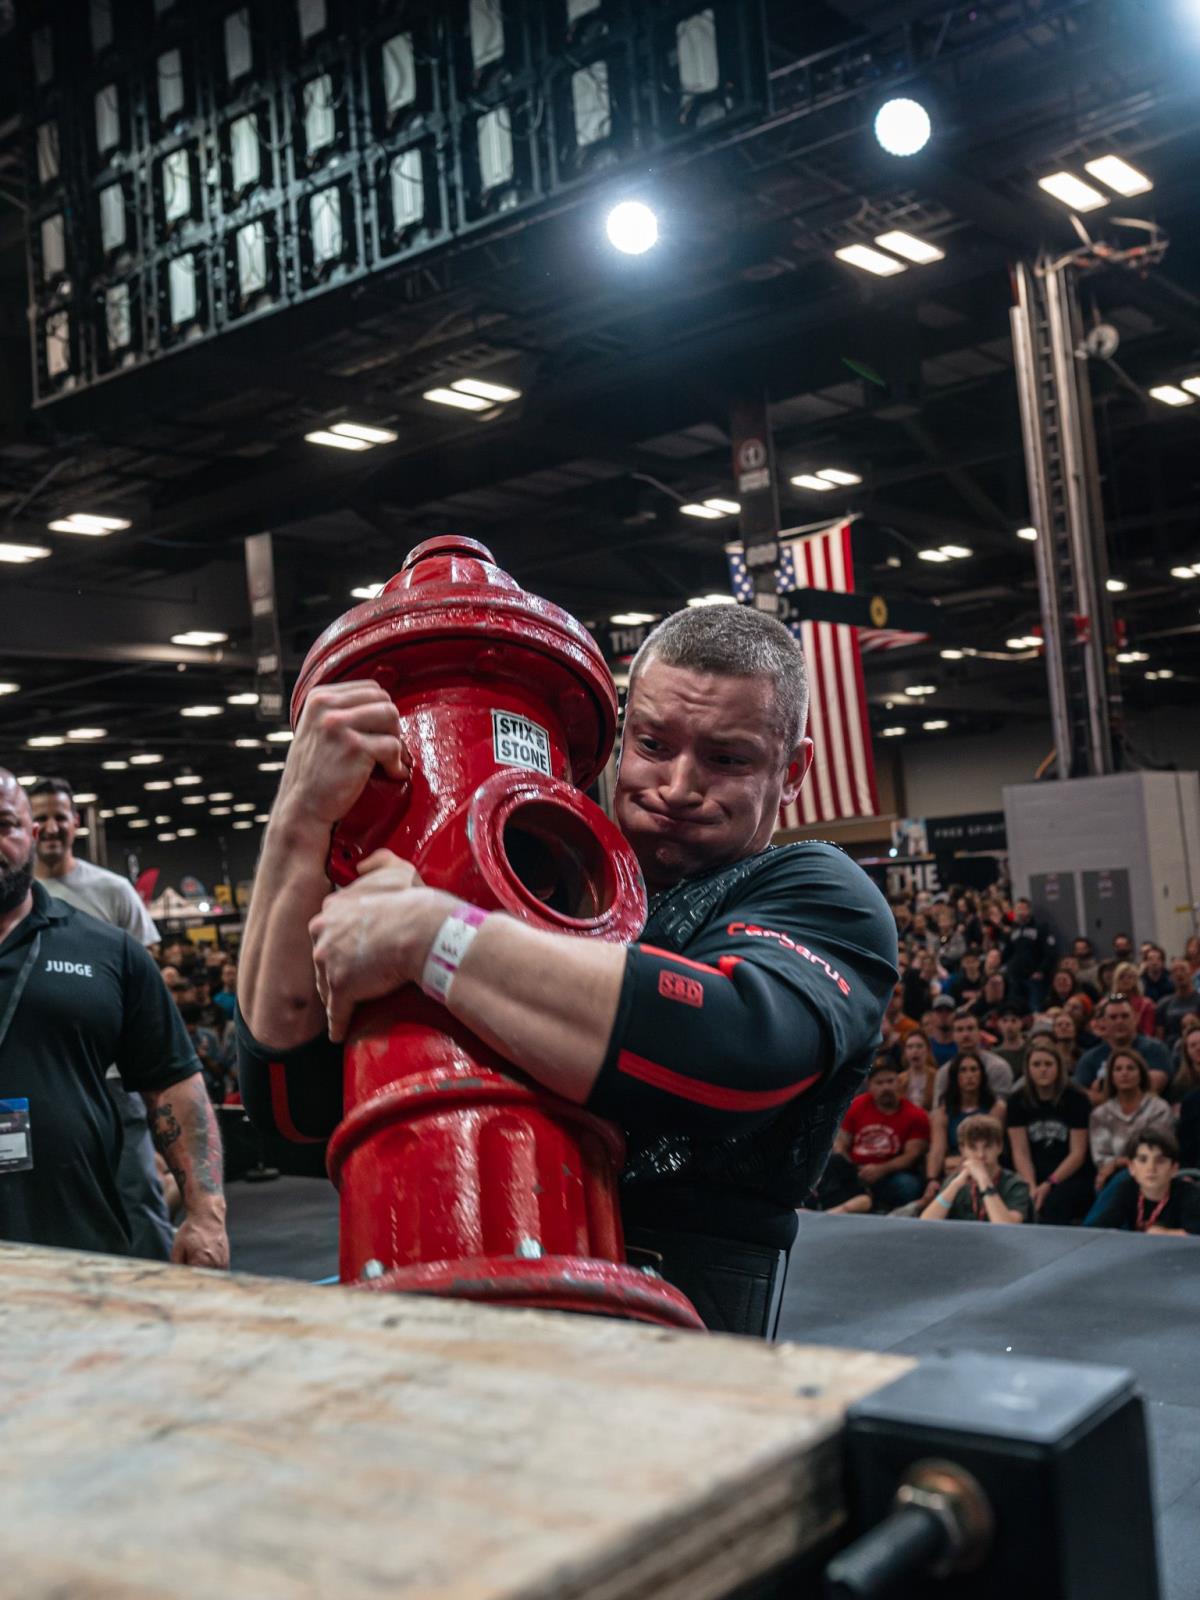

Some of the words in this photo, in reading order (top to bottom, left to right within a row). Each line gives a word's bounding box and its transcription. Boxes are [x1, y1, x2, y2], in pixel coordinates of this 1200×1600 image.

[500, 717, 534, 745] STIX
[501, 740, 547, 772] STONE
[886, 864, 940, 896] THE
[45, 959, 93, 978] JUDGE
[660, 971, 703, 1007] SBD
